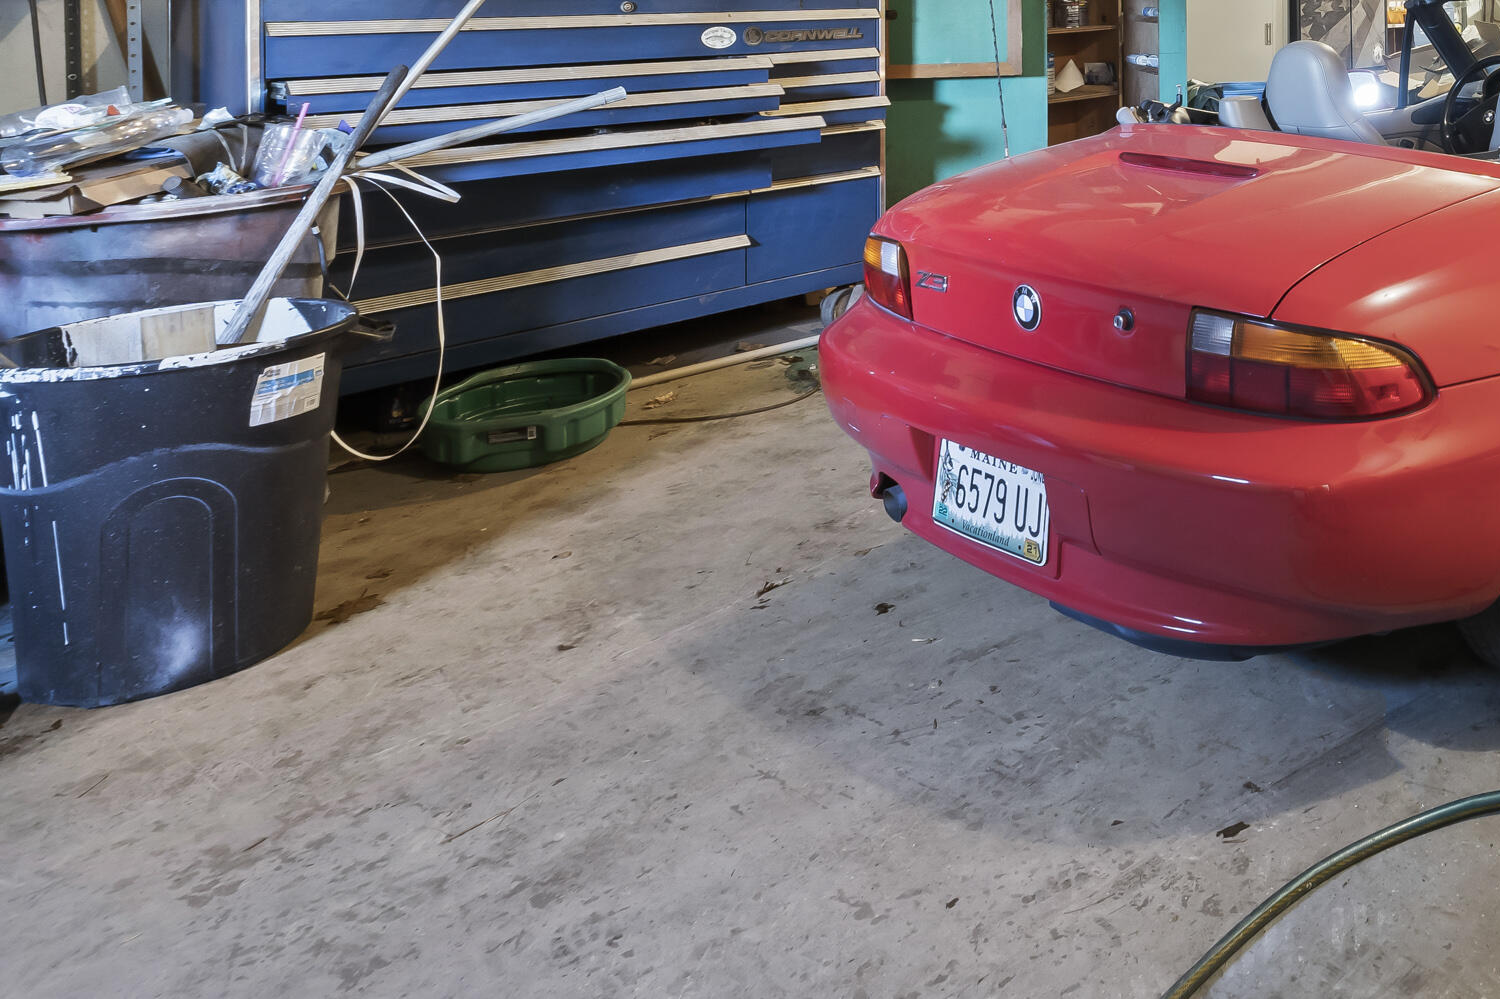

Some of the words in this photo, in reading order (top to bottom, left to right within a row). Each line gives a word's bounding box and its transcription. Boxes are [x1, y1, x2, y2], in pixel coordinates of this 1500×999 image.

[764, 27, 864, 43] CORNWELL
[915, 270, 949, 293] Z3
[970, 449, 1018, 475] MAINE
[955, 464, 1008, 524] 6579
[1014, 484, 1043, 538] UJ
[961, 519, 1011, 547] Vacationland
